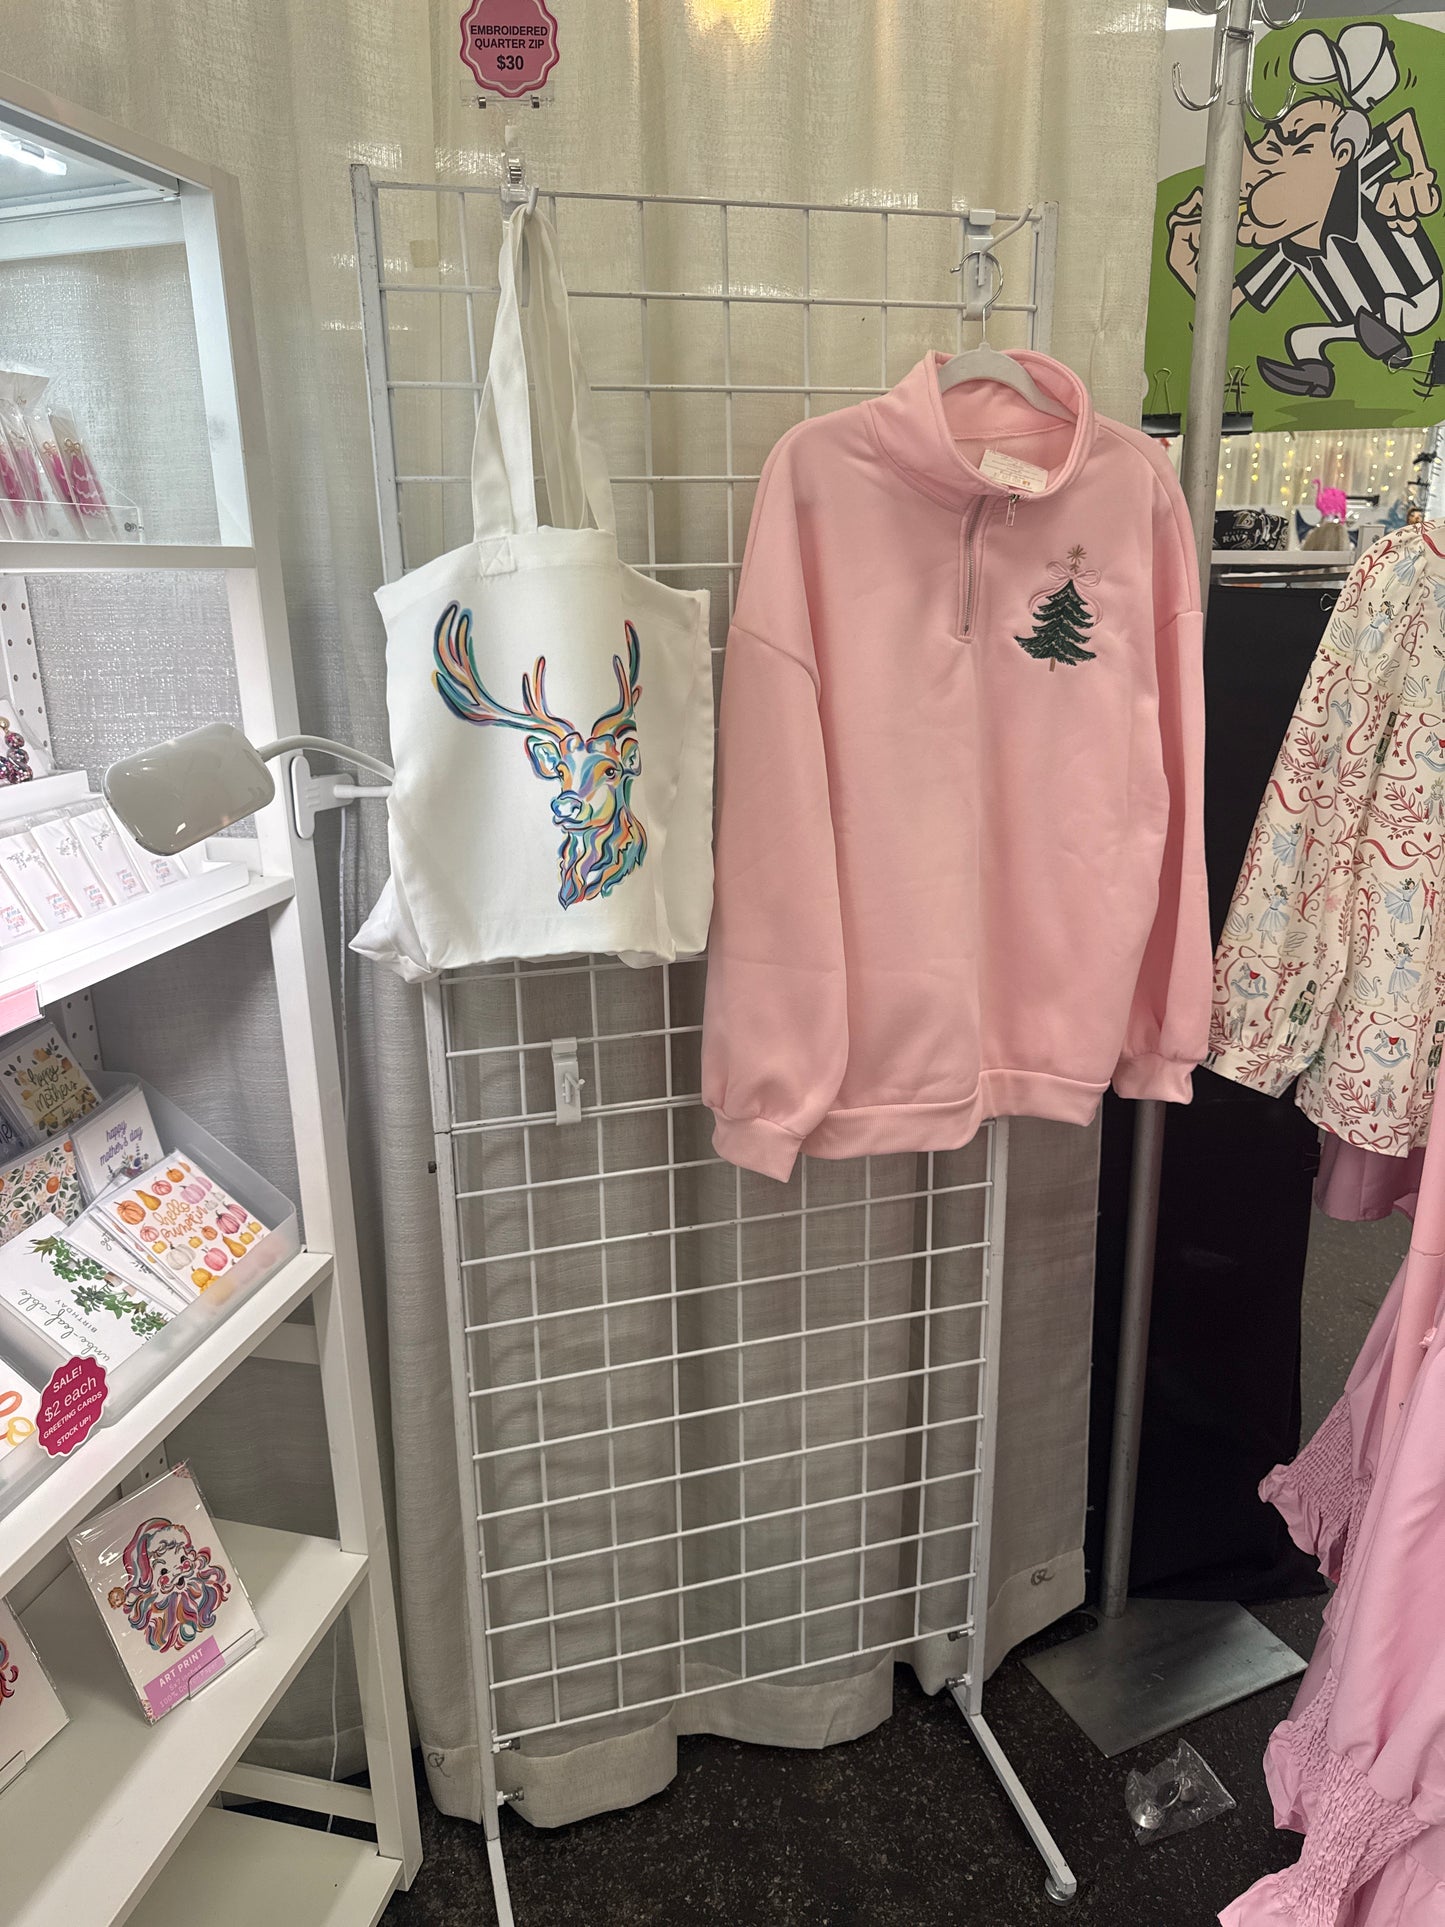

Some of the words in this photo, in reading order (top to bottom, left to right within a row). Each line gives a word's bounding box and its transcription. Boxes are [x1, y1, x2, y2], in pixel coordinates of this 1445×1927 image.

[470, 25, 548, 36] EMBROIDERED
[474, 38, 526, 50] QUARTER
[528, 39, 544, 49] ZIP
[496, 54, 524, 71] $30
[106, 1120, 127, 1142] happy
[129, 1126, 144, 1142] day
[153, 1199, 190, 1226] hello
[55, 1299, 98, 1333] BIRTHDAY
[53, 1365, 82, 1393] SALE!
[44, 1400, 61, 1422] $2
[64, 1377, 97, 1407] each
[43, 1408, 77, 1439] GREETING
[77, 1391, 102, 1412] CARDS
[57, 1424, 79, 1446] STOCK
[80, 1415, 92, 1428] UP!
[159, 1669, 179, 1688] ART
[177, 1648, 203, 1673] PRINT
